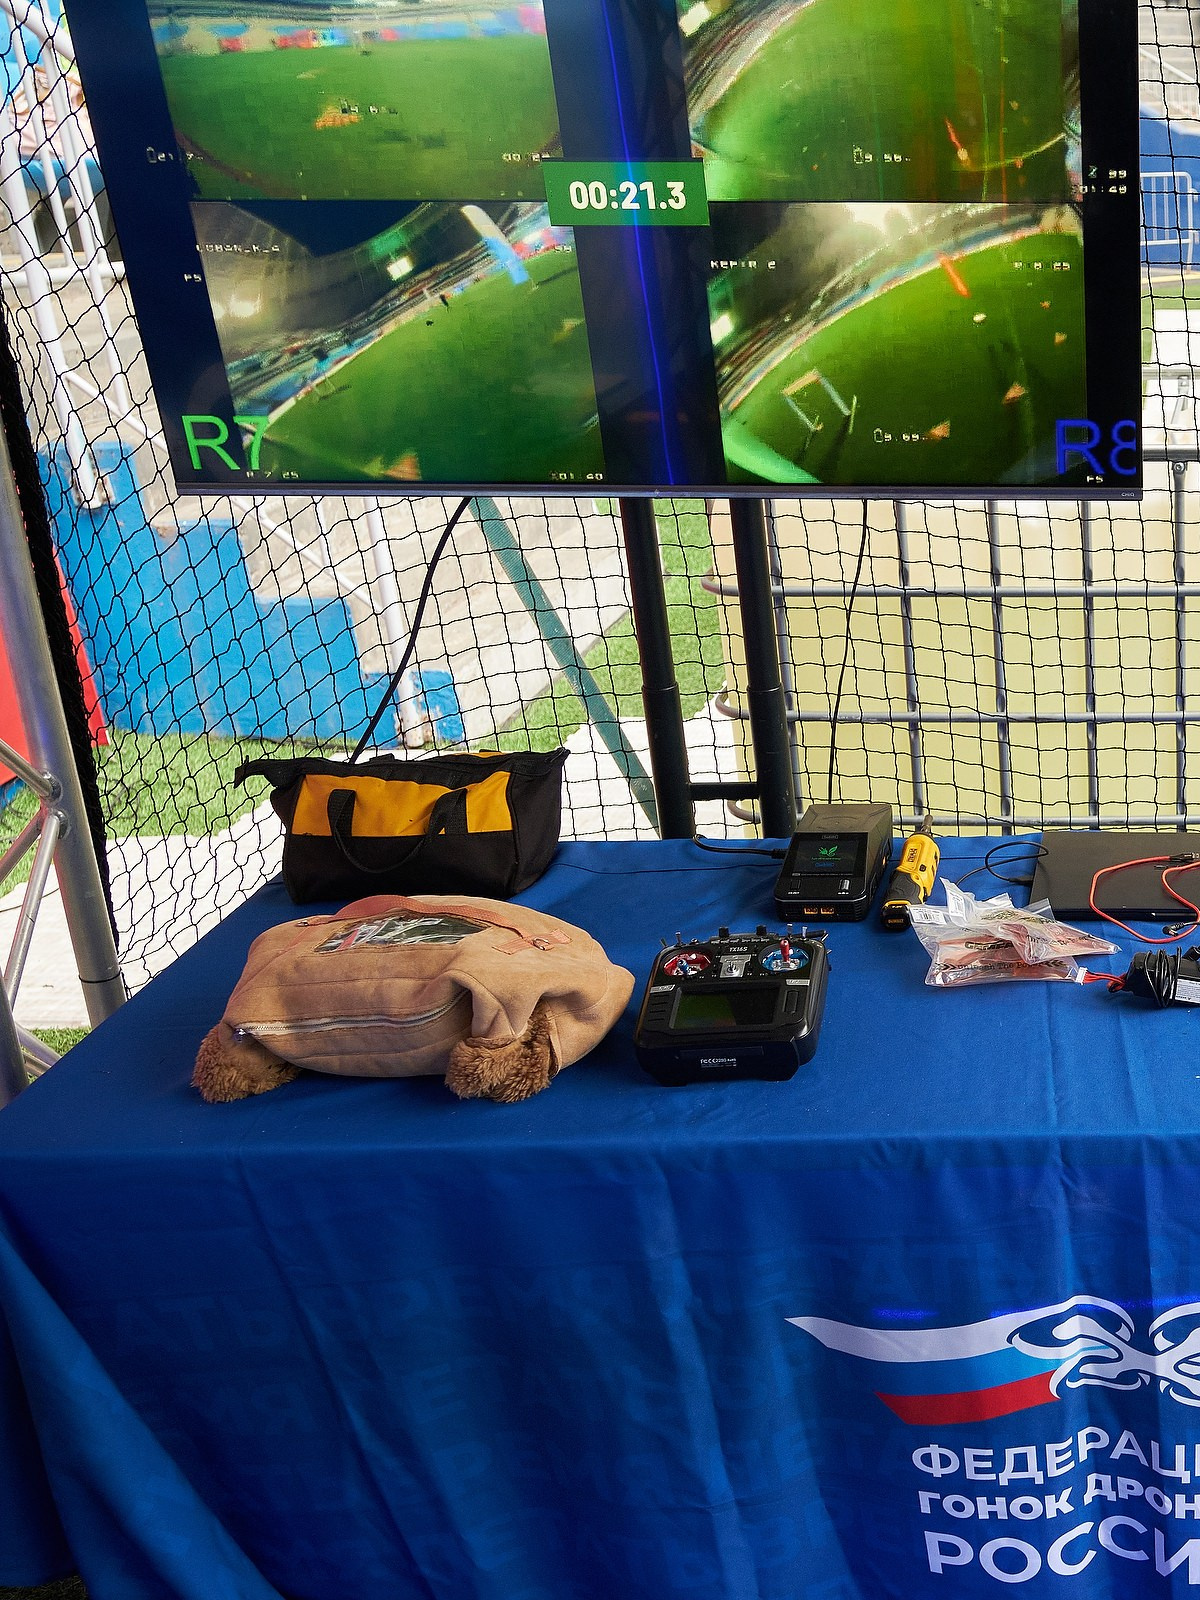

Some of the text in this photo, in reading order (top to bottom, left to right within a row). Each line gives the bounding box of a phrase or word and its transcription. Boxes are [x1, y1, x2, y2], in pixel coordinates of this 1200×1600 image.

[568, 180, 687, 211] 00:21.3
[181, 415, 269, 470] R7
[1056, 419, 1137, 475] R8
[918, 1486, 1075, 1521] ГОНОК
